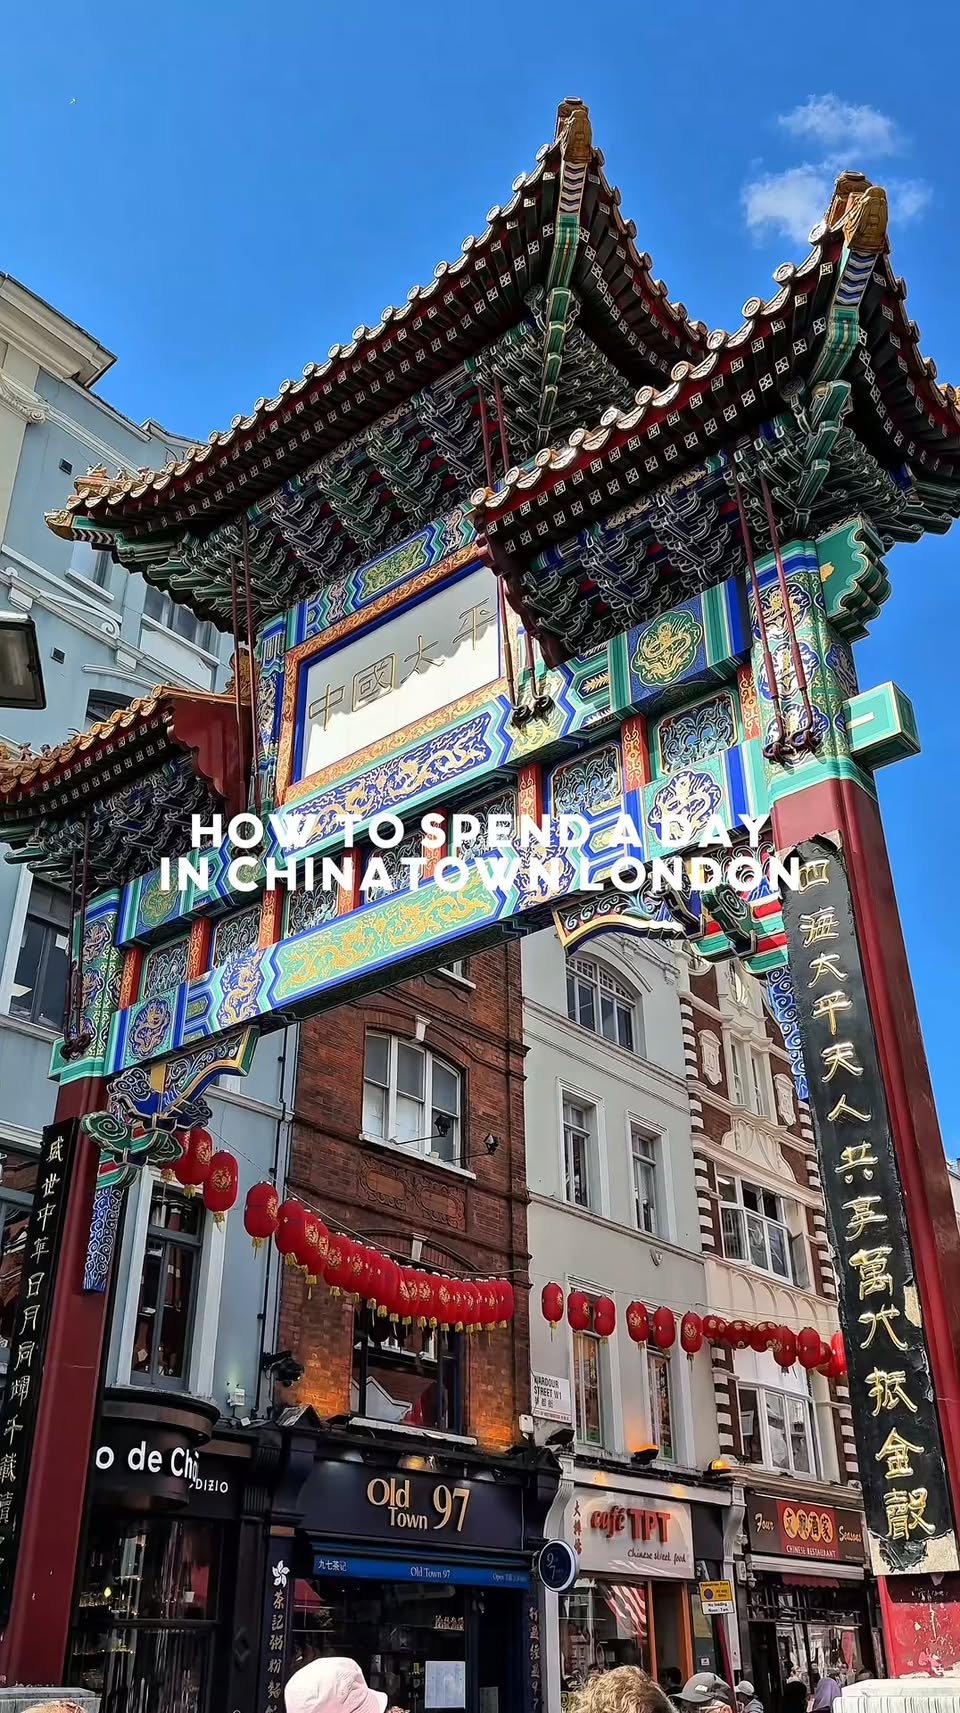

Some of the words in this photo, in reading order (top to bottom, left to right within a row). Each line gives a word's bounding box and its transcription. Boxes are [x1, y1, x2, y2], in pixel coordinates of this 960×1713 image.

[308, 597, 497, 731] 中國太平
[534, 1376, 560, 1389] WARDOUR
[534, 1385, 553, 1397] STREET
[554, 1390, 562, 1400] W1
[127, 1440, 163, 1473] de
[366, 1477, 411, 1509] Old
[387, 1505, 429, 1531] Town
[432, 1483, 471, 1533] 97
[590, 1505, 627, 1539] café
[627, 1508, 671, 1543] TPT
[754, 1512, 775, 1533] Four
[838, 1525, 862, 1543] Seasons
[627, 1547, 653, 1560] Chinese
[653, 1550, 672, 1562] street
[673, 1553, 687, 1566] food
[786, 1545, 806, 1556] CHINESE
[807, 1547, 836, 1559] RESTAURANT
[410, 1565, 423, 1578] Old
[424, 1567, 442, 1579] Town
[442, 1569, 451, 1580] 97
